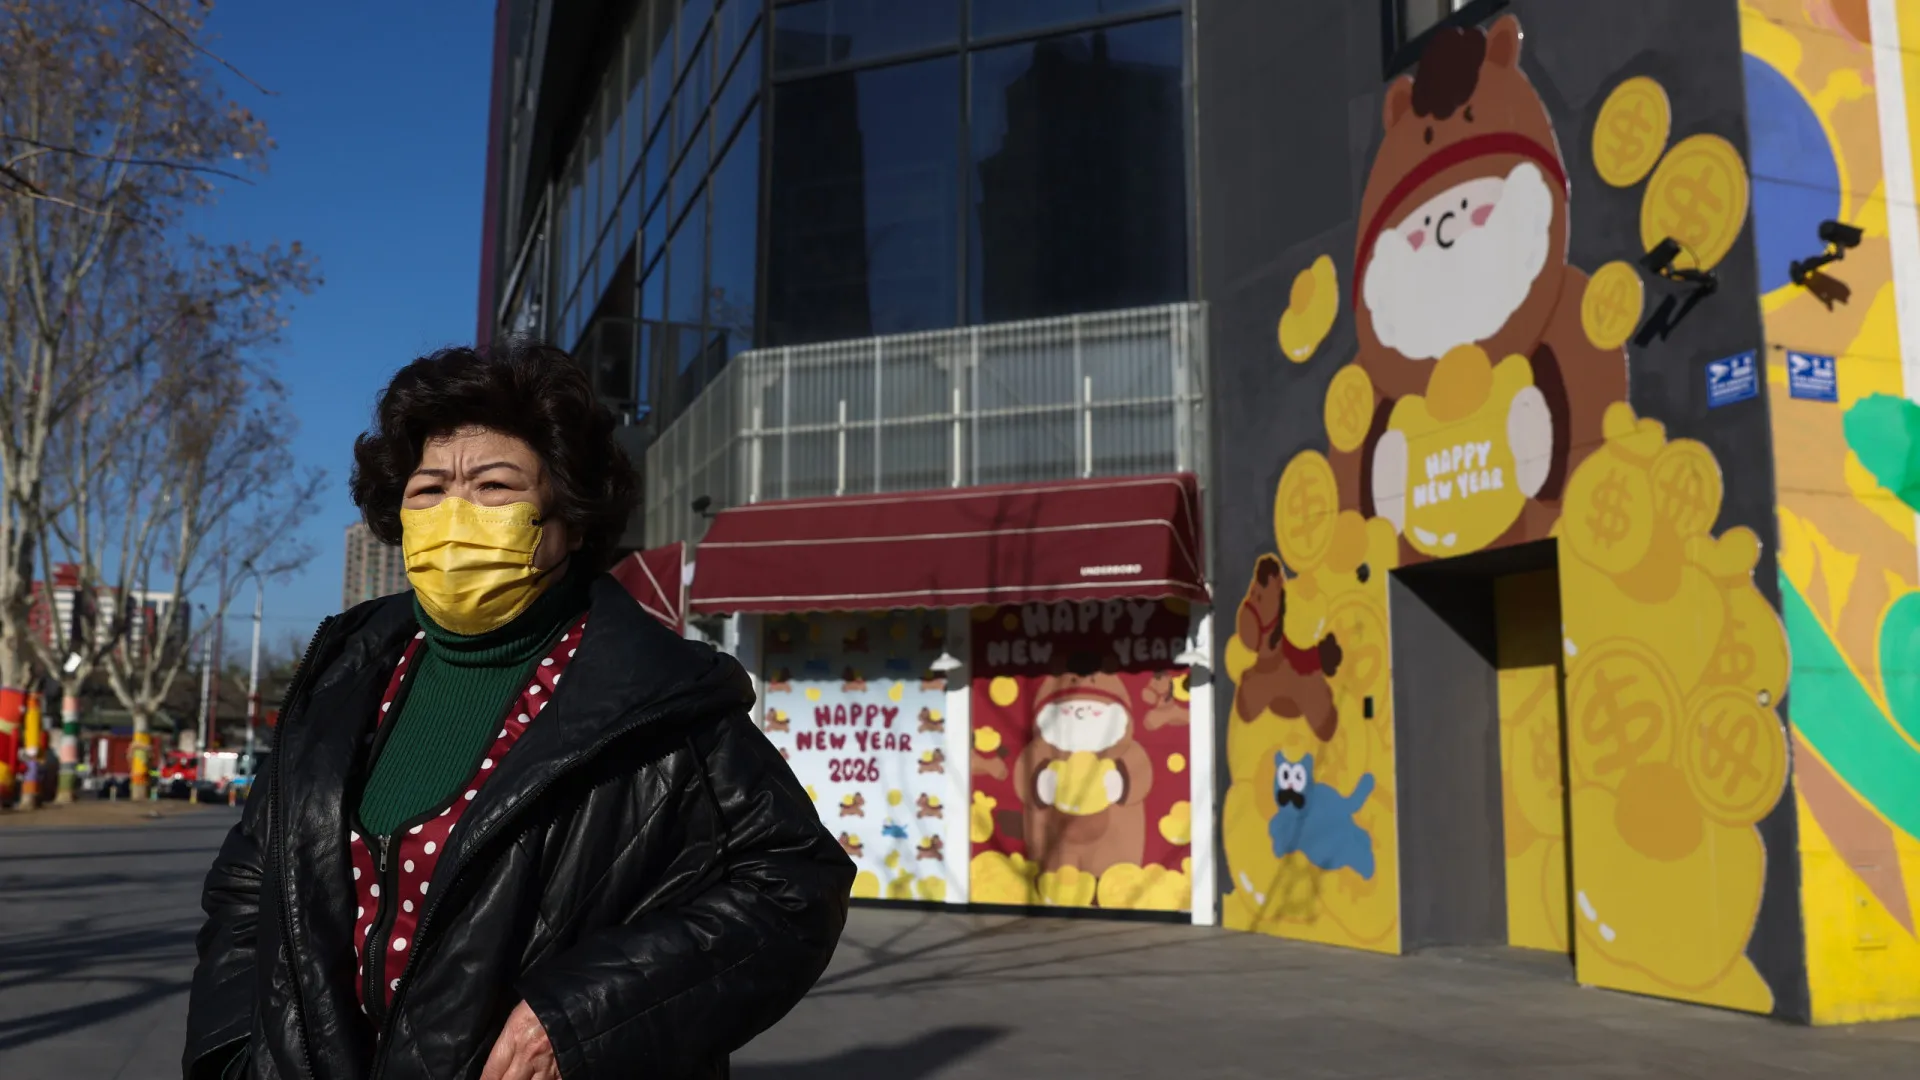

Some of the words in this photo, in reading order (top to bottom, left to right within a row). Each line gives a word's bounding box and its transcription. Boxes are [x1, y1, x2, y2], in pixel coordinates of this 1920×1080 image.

[1425, 440, 1492, 479] HAPPY
[1413, 480, 1453, 508] NEW
[1457, 466, 1504, 499] YEAR
[1021, 599, 1155, 637] HAPPY
[987, 640, 1053, 666] NEW
[814, 703, 899, 728] HAPPY
[796, 731, 846, 751] NEW
[855, 729, 912, 752] YEAR
[829, 757, 880, 782] 2026
